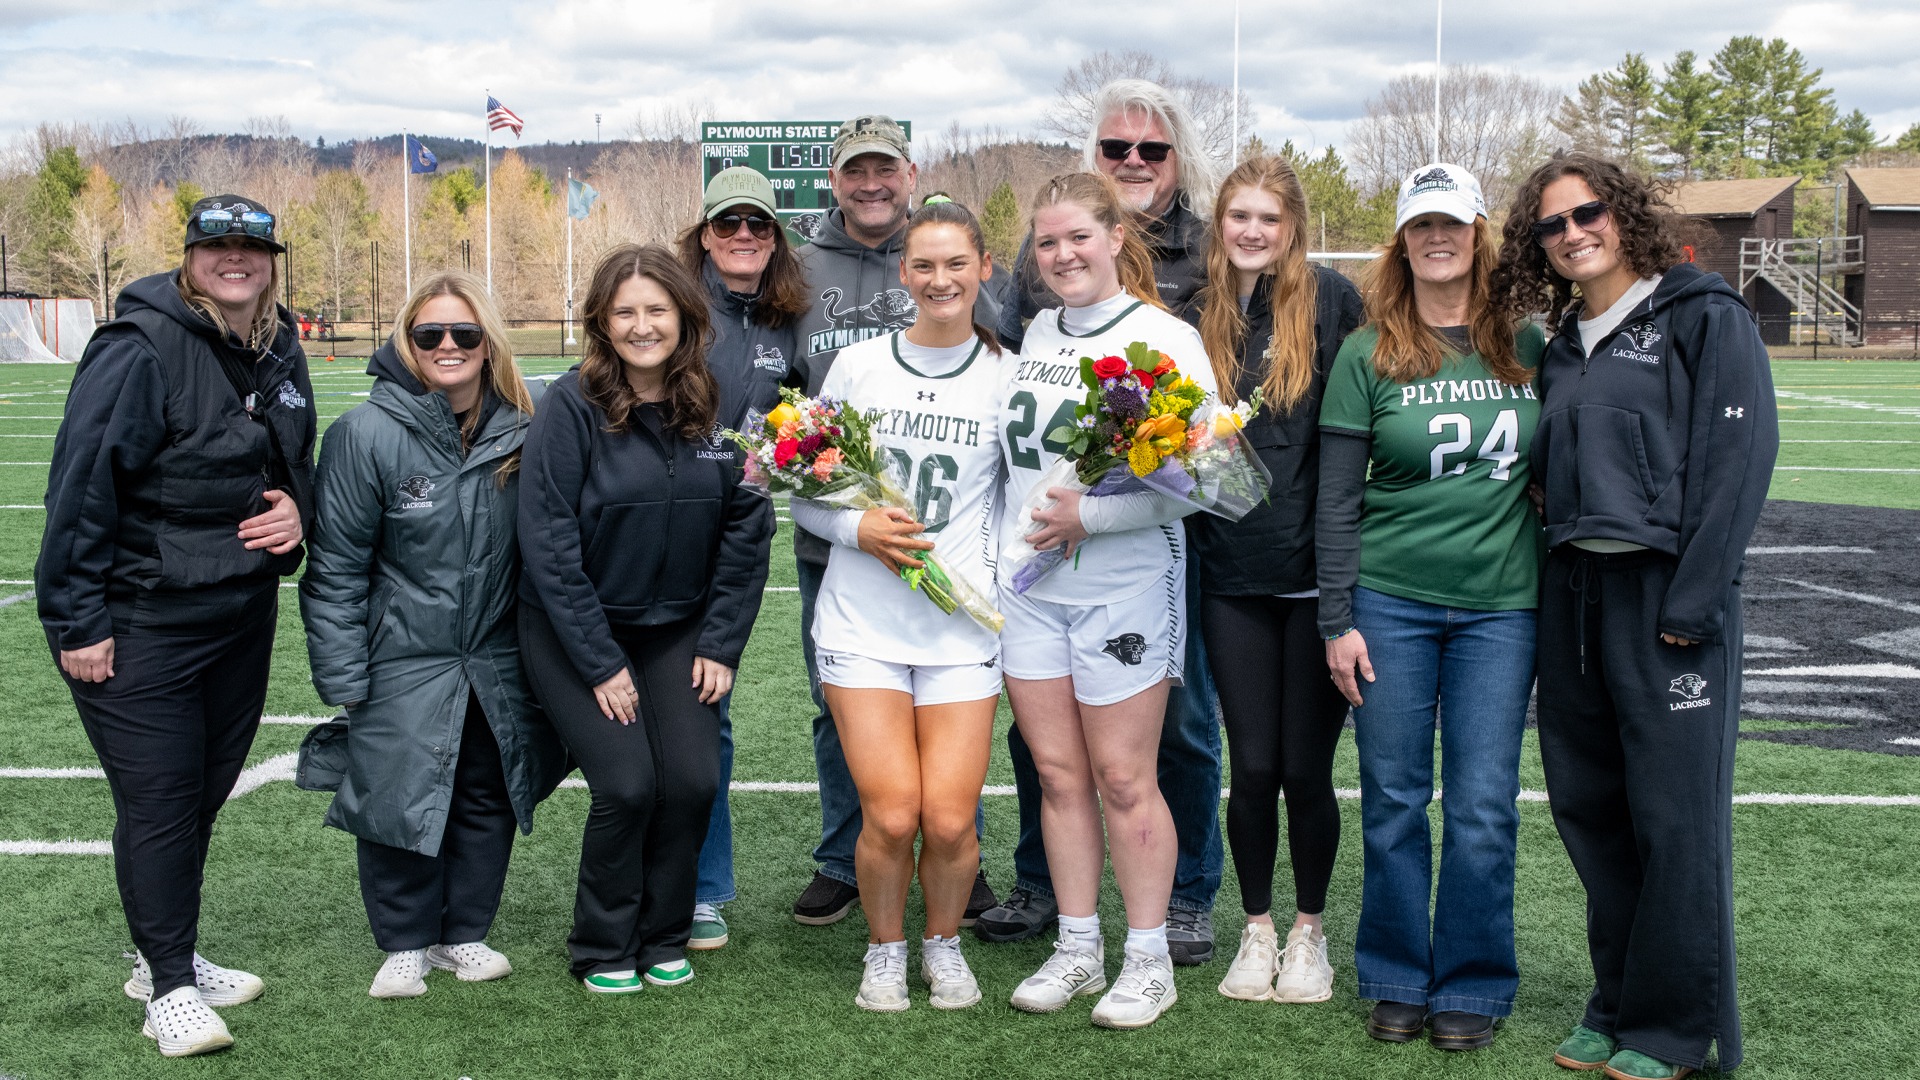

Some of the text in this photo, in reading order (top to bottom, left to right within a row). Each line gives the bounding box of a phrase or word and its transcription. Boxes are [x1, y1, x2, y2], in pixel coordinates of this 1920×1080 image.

[707, 126, 783, 139] PLYMOUTH
[785, 126, 827, 138] STATE
[704, 145, 750, 157] PANTHERS
[721, 174, 761, 186] PLYMOUTH
[783, 179, 796, 190] GO
[728, 182, 756, 192] STATE
[1408, 180, 1437, 197] PLYMOUTH
[1437, 180, 1458, 191] STATE
[1155, 281, 1179, 289] lumbia
[1612, 348, 1660, 364] LACROSSE
[1012, 360, 1084, 390] PLYMOU
[1401, 379, 1538, 407] PLYMOUTH
[1428, 408, 1519, 481] 24
[696, 451, 735, 460] LACROSSE
[402, 501, 433, 509] LACROSSE
[1670, 698, 1711, 711] LACROSSE
